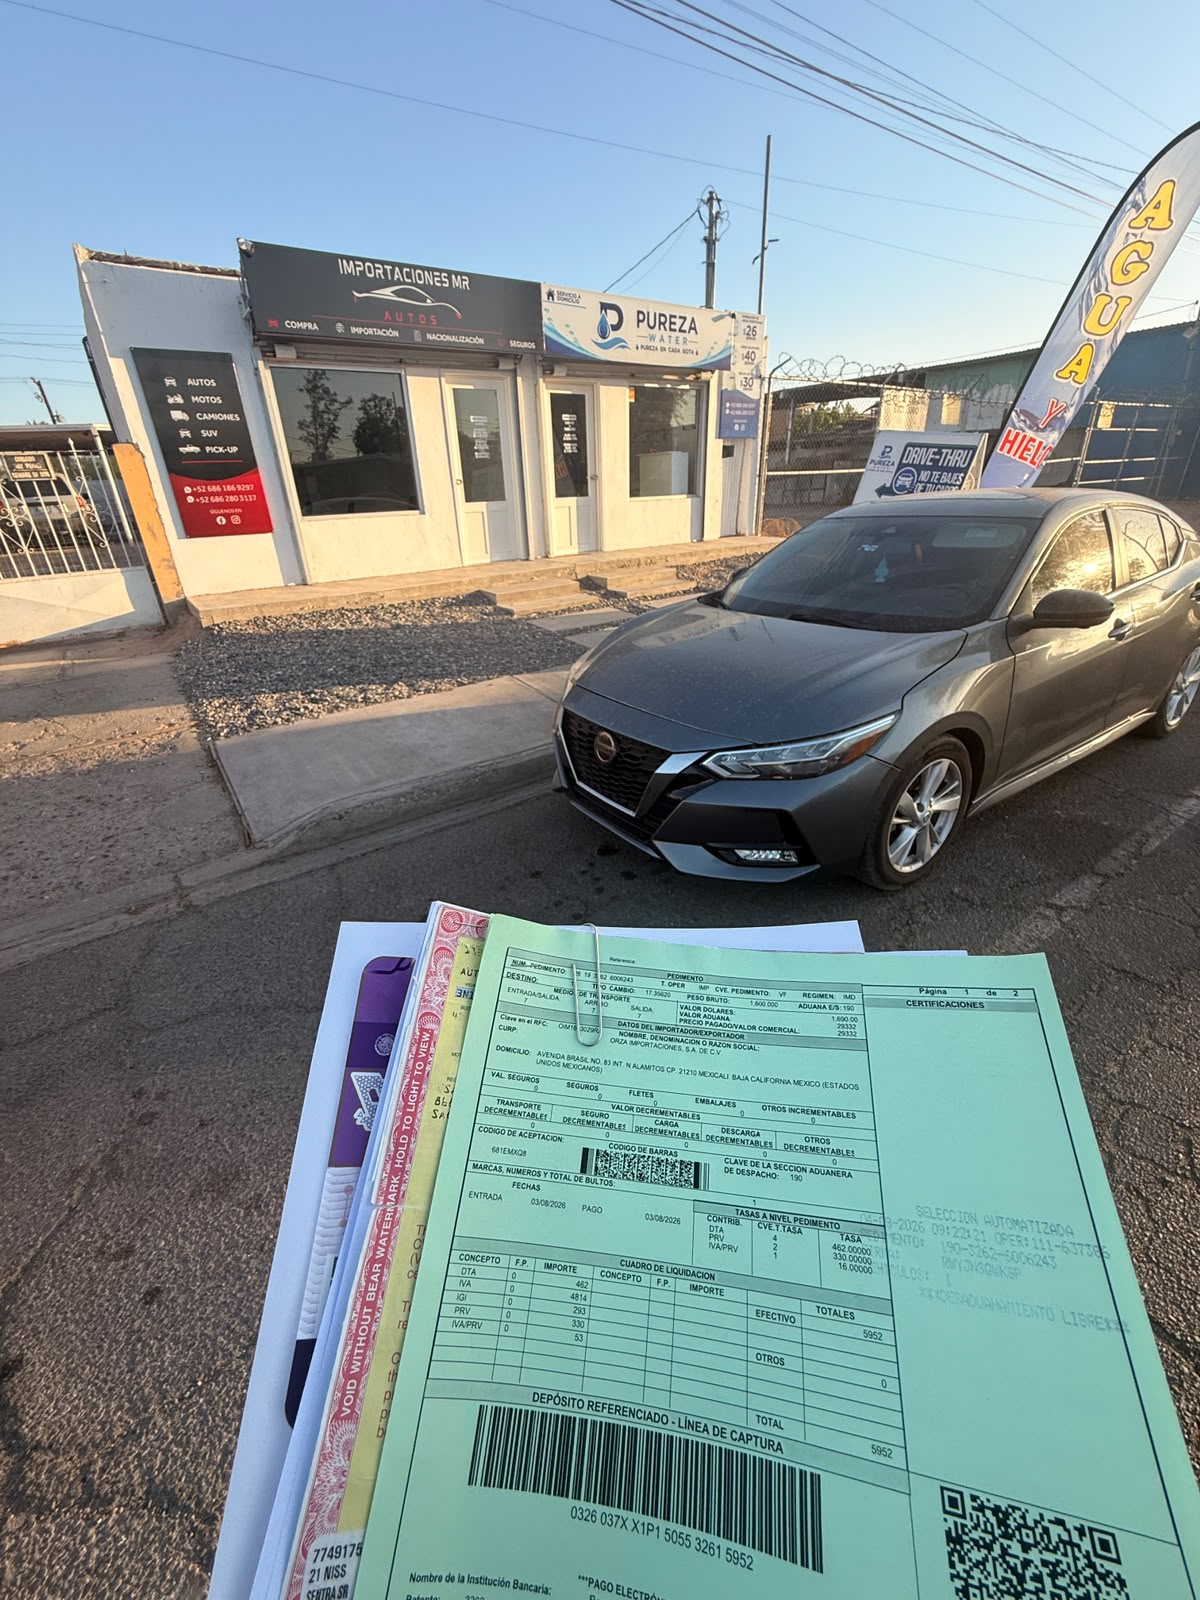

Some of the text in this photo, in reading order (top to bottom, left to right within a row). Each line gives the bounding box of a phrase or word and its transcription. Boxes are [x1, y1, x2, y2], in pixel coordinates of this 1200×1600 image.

[338, 258, 470, 290] IMPORTACIONES MR
[1055, 179, 1176, 384] AGUA
[557, 290, 577, 299] SERVICIO
[557, 296, 580, 304] DOMICILIO
[384, 310, 438, 326] AUTOS
[636, 310, 698, 335] PUREZA
[285, 320, 319, 331] COMPRA
[743, 325, 757, 337] $26
[350, 326, 399, 338] IMPORTACIÓN
[426, 332, 484, 345] NACIONALIZACIÓN
[648, 333, 689, 345] WATER
[510, 340, 536, 350] SEGUROS
[640, 344, 658, 352] PUREZA
[742, 350, 756, 362] $40
[187, 378, 216, 387] AUTOS
[740, 376, 754, 388] $30
[191, 395, 222, 404] MOTOS
[196, 413, 240, 422] CAMIONES
[1040, 398, 1066, 429] Y
[205, 445, 238, 454] PICK-UP
[869, 458, 895, 467] PUREZA
[902, 446, 973, 468] DRIVE-THRU
[918, 470, 964, 485] NO TE BAJES
[193, 485, 206, 493] +52
[222, 484, 236, 492] 186
[236, 483, 254, 491] 9297
[196, 495, 209, 503] +52
[210, 495, 224, 503] 686
[667, 973, 704, 982] PEDIMENTO
[919, 988, 947, 996] Página
[906, 1000, 984, 1009] CERTIFICACIONES
[498, 1025, 518, 1034] CURP:
[495, 1045, 532, 1056] DOMICILIO:
[537, 1051, 565, 1061] AVENIDA
[566, 1054, 589, 1063] BRASIL
[632, 1063, 665, 1072] ALAMITOS
[699, 1070, 729, 1080] MEXICALI
[732, 1074, 749, 1082] BAJA
[750, 1076, 791, 1086] CALIFORNIA
[793, 1079, 820, 1088] MEXICO
[822, 1082, 860, 1091] (ESTADOS
[536, 1059, 603, 1074] UNIDOS MEXICANOS)
[566, 1082, 599, 1092] SEGUROS
[629, 1090, 654, 1098] FLETES
[496, 1099, 542, 1111] TRANSPORTE
[695, 1098, 736, 1108] EMBALAJES
[580, 1110, 610, 1119] SEGURO
[611, 1104, 700, 1121] VALOR DECREMENTABLES
[762, 1105, 857, 1120] OTROS INCREMENTABLES
[654, 1119, 679, 1129] CARGA
[478, 1126, 564, 1144] CODIGO DE ACEPTACION:
[635, 1125, 700, 1140] DECREMENTABLES
[721, 1127, 761, 1138] DESCARGA
[706, 1134, 773, 1149] DECREMENTABLES
[804, 1136, 831, 1145] OTROS
[608, 1143, 678, 1158] CODIGO DE BARRAS
[724, 1157, 853, 1179] CLAVE DE LA SECCION ADUANERA
[511, 1181, 541, 1191] FECHAS
[468, 1191, 681, 1225] ENTRADA 03/08/2026 PAGO 03/08/2026
[341, 1029, 430, 1418] VOID WITHOUT BEAR WATERMARK. HOLD TO LIGHT TO VIEW.
[707, 1215, 742, 1226] CONTRIB.
[915, 1205, 1074, 1237] SELECCION AUTOMATIZADA
[758, 1222, 803, 1235] CVE.T.TASA
[840, 1234, 862, 1244] TASA
[708, 1242, 738, 1252] IVA/PRV
[620, 1258, 716, 1281] CUADRO DE LIQUIDACION
[458, 1254, 725, 1298] CONCEPTO F.P. IMPORTE CONCEPTO F.P. IMPORTE
[755, 1309, 796, 1324] EFECTIVO
[816, 1306, 855, 1320] TOTALES
[863, 1330, 883, 1341] 5952
[532, 1391, 585, 1409] DEPÓSITO
[586, 1400, 669, 1425] REFERENCIADO
[677, 1416, 710, 1434] LÍNEA
[712, 1426, 727, 1439] DE
[730, 1430, 783, 1454] CAPTURA
[756, 1414, 893, 1459] TOTAL 5952
[570, 1506, 754, 1571] 0326 037X X1P1 5055 3261 5952
[313, 1542, 363, 1563] 7749175
[309, 1564, 346, 1583] 21 NISS
[410, 1572, 552, 1596] Nombre de la Institución Bancaria:
[336, 1584, 349, 1599] SR
